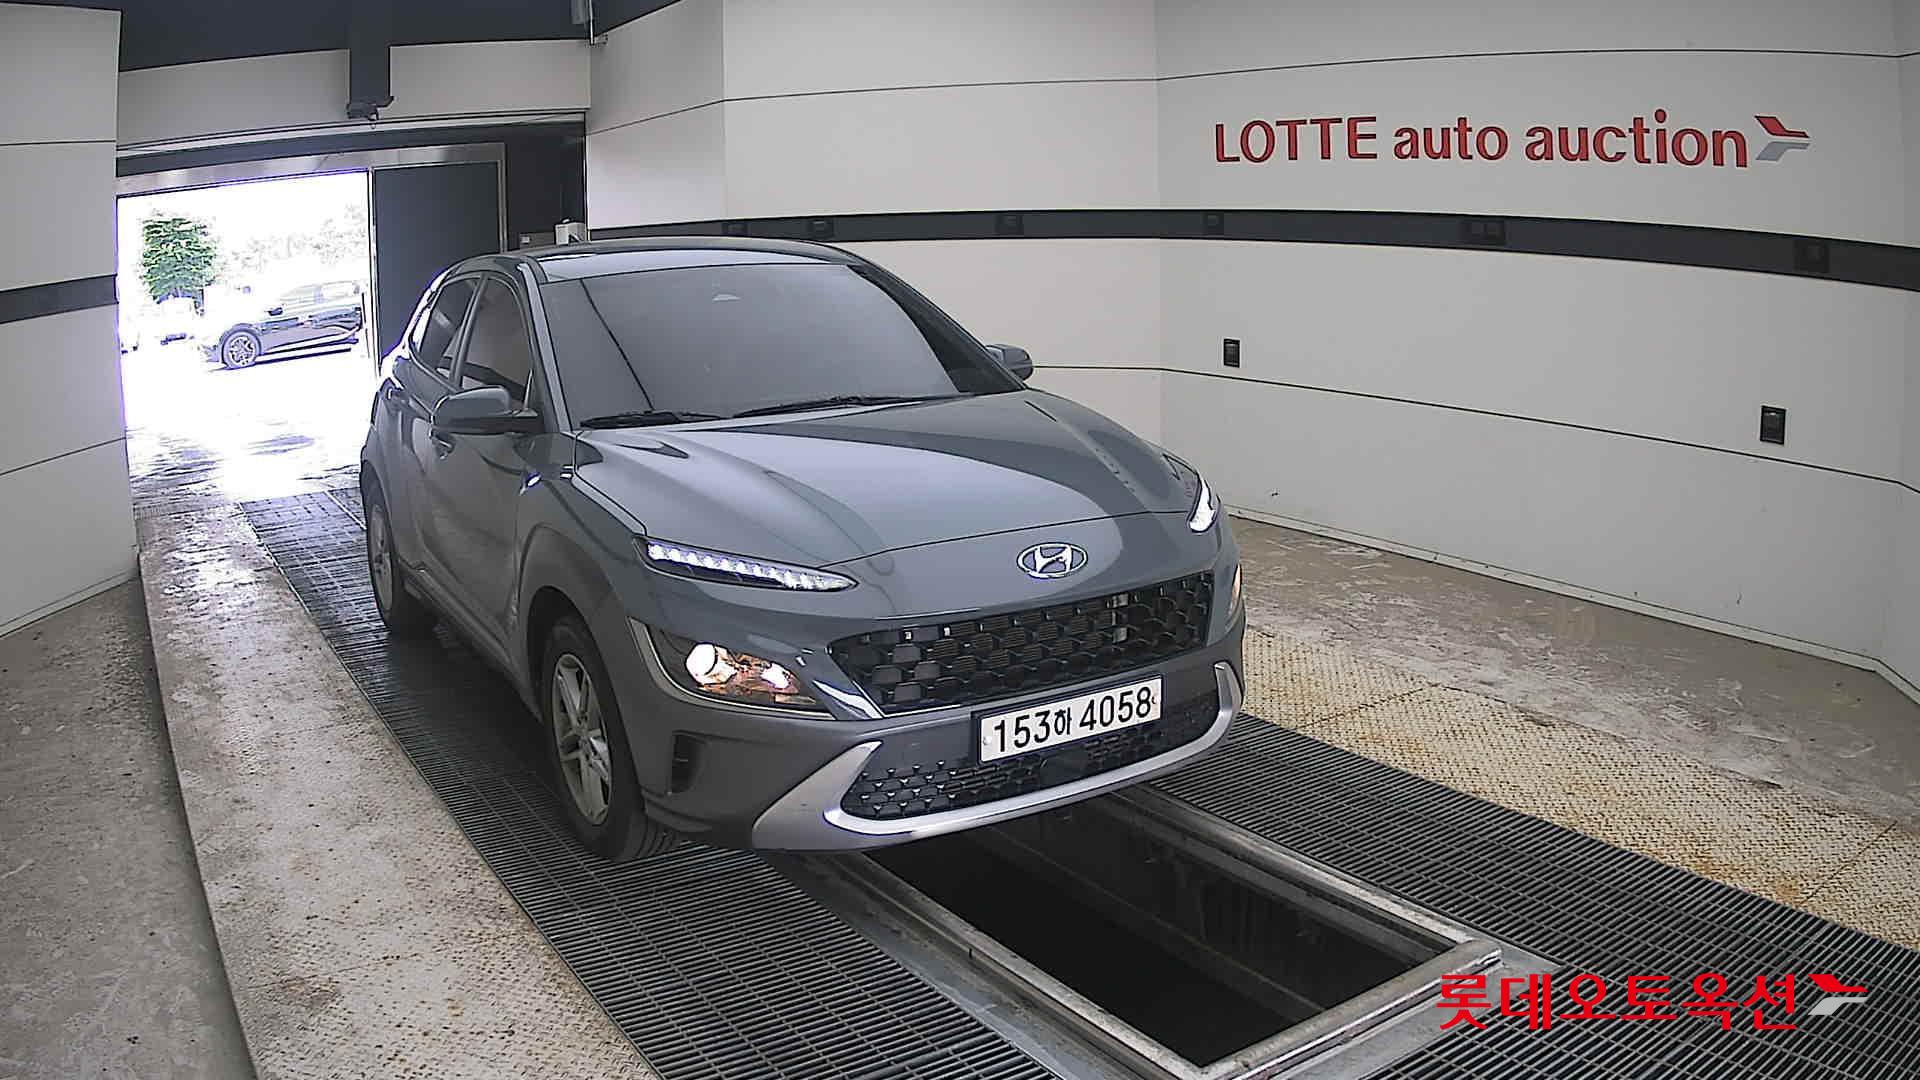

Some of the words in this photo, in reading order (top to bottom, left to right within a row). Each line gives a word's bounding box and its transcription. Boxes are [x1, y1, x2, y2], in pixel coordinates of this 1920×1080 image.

[1215, 115, 1377, 163] LOTTE
[1393, 116, 1510, 162] auto
[1525, 108, 1748, 168] auction
[993, 706, 1072, 753] 153하
[1079, 686, 1152, 731] 4058
